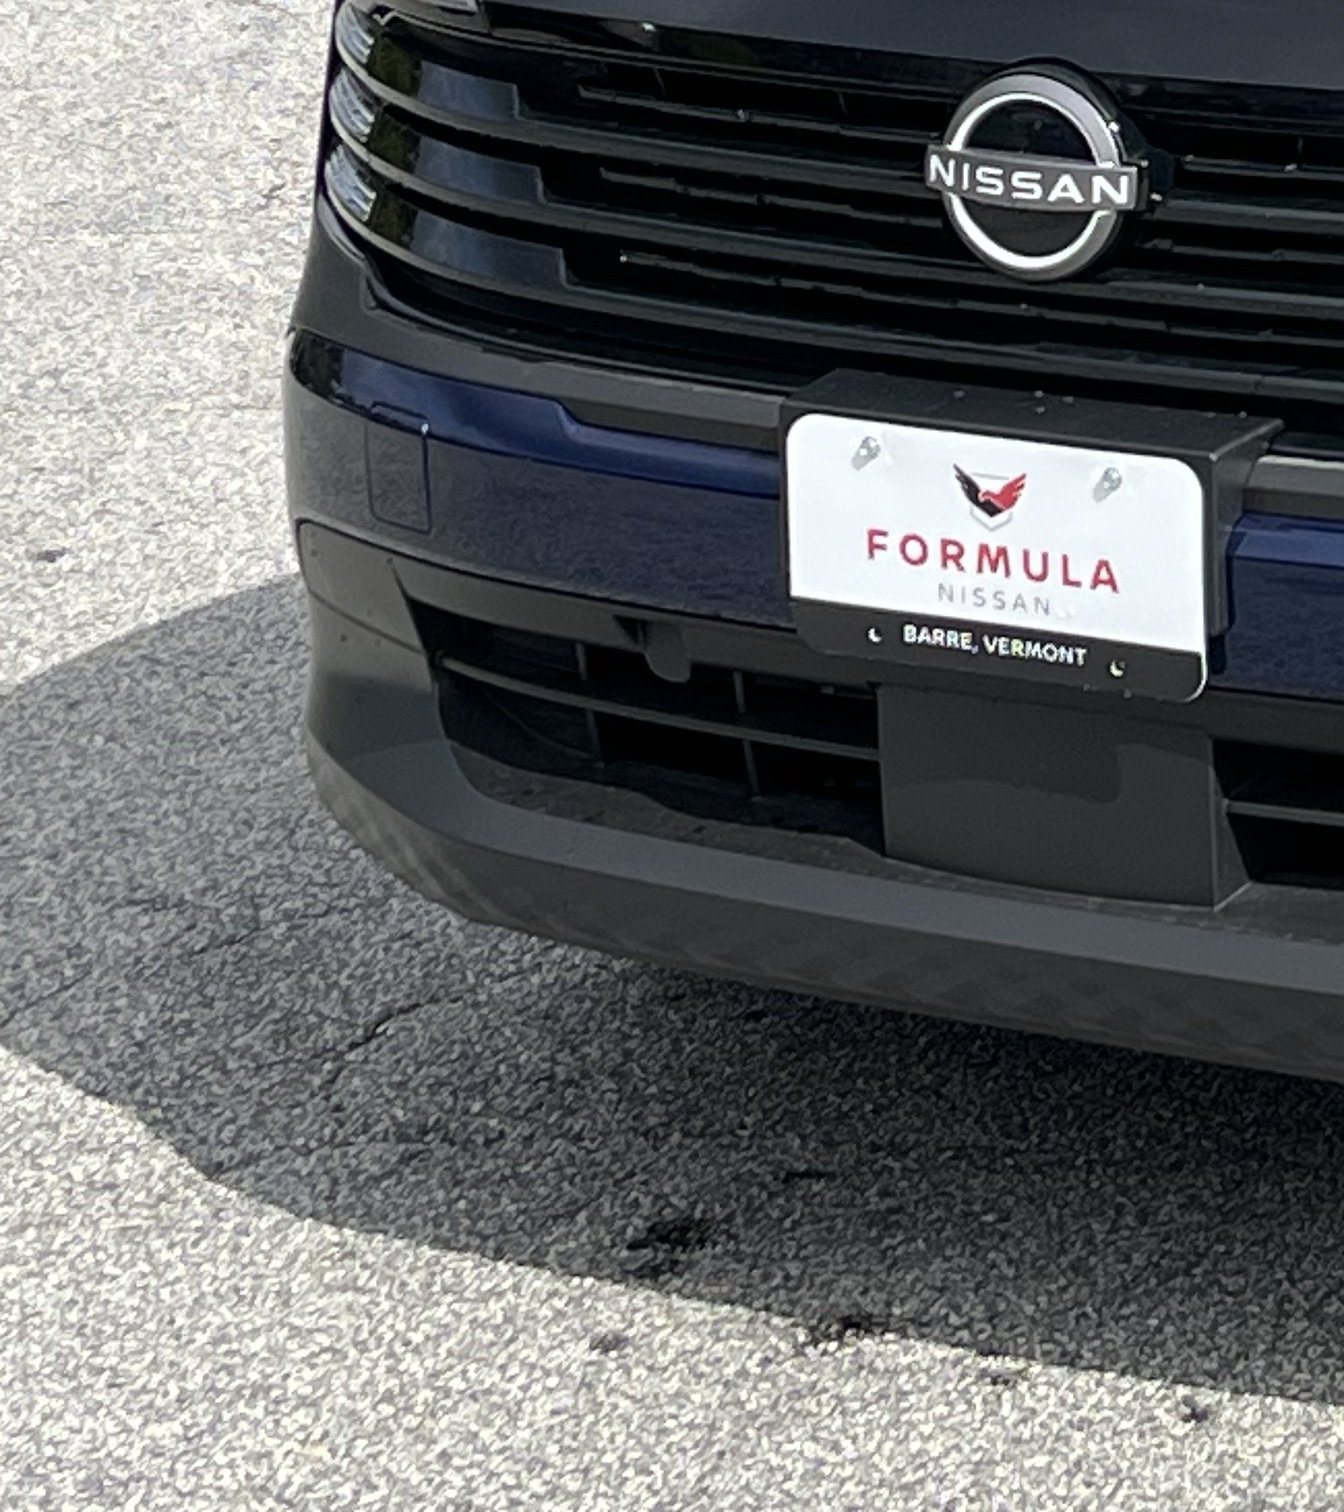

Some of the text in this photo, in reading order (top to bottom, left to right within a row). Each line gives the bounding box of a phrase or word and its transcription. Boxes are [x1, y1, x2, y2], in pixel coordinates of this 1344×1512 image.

[928, 154, 1130, 205] NISSAN
[867, 528, 1119, 593] FORMULA
[938, 583, 1051, 616] NISSAN
[903, 624, 1088, 667] BARRE, VERMONT
